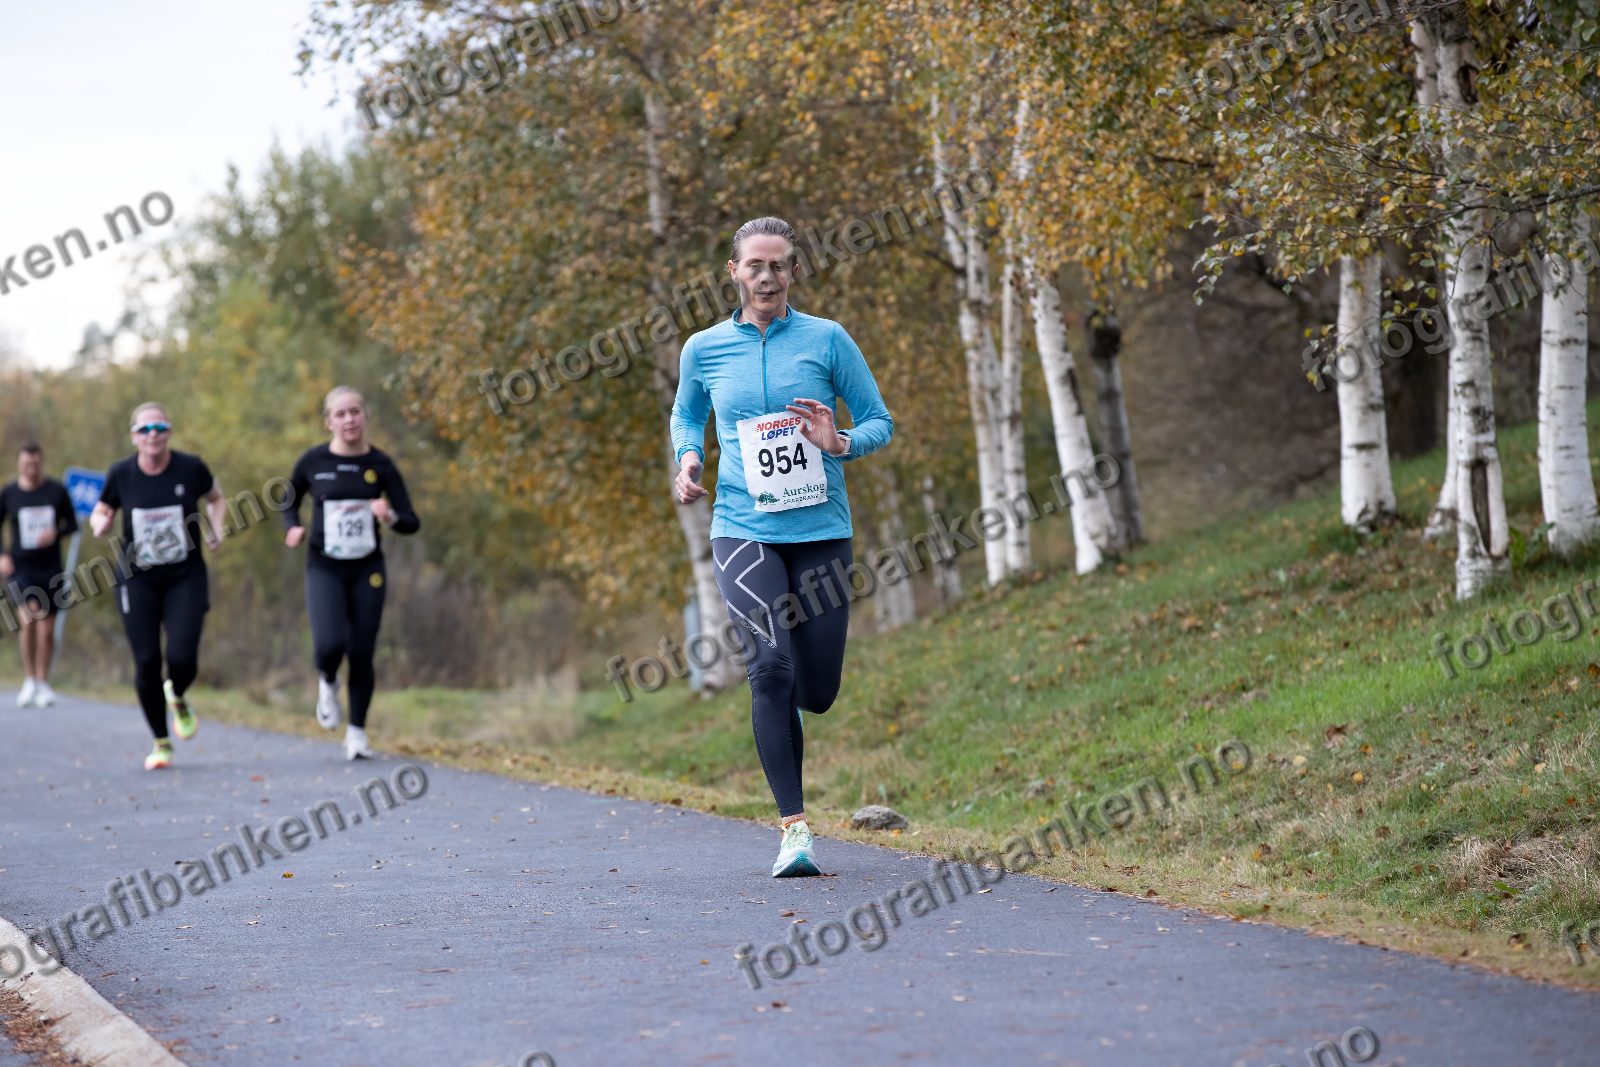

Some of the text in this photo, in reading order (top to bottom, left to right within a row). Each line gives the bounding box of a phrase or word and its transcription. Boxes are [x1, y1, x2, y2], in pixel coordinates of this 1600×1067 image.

[756, 417, 801, 432] NORGES
[762, 426, 796, 441] LØPET
[758, 443, 807, 477] 954
[782, 483, 825, 497] Aurskog
[337, 518, 364, 538] 129
